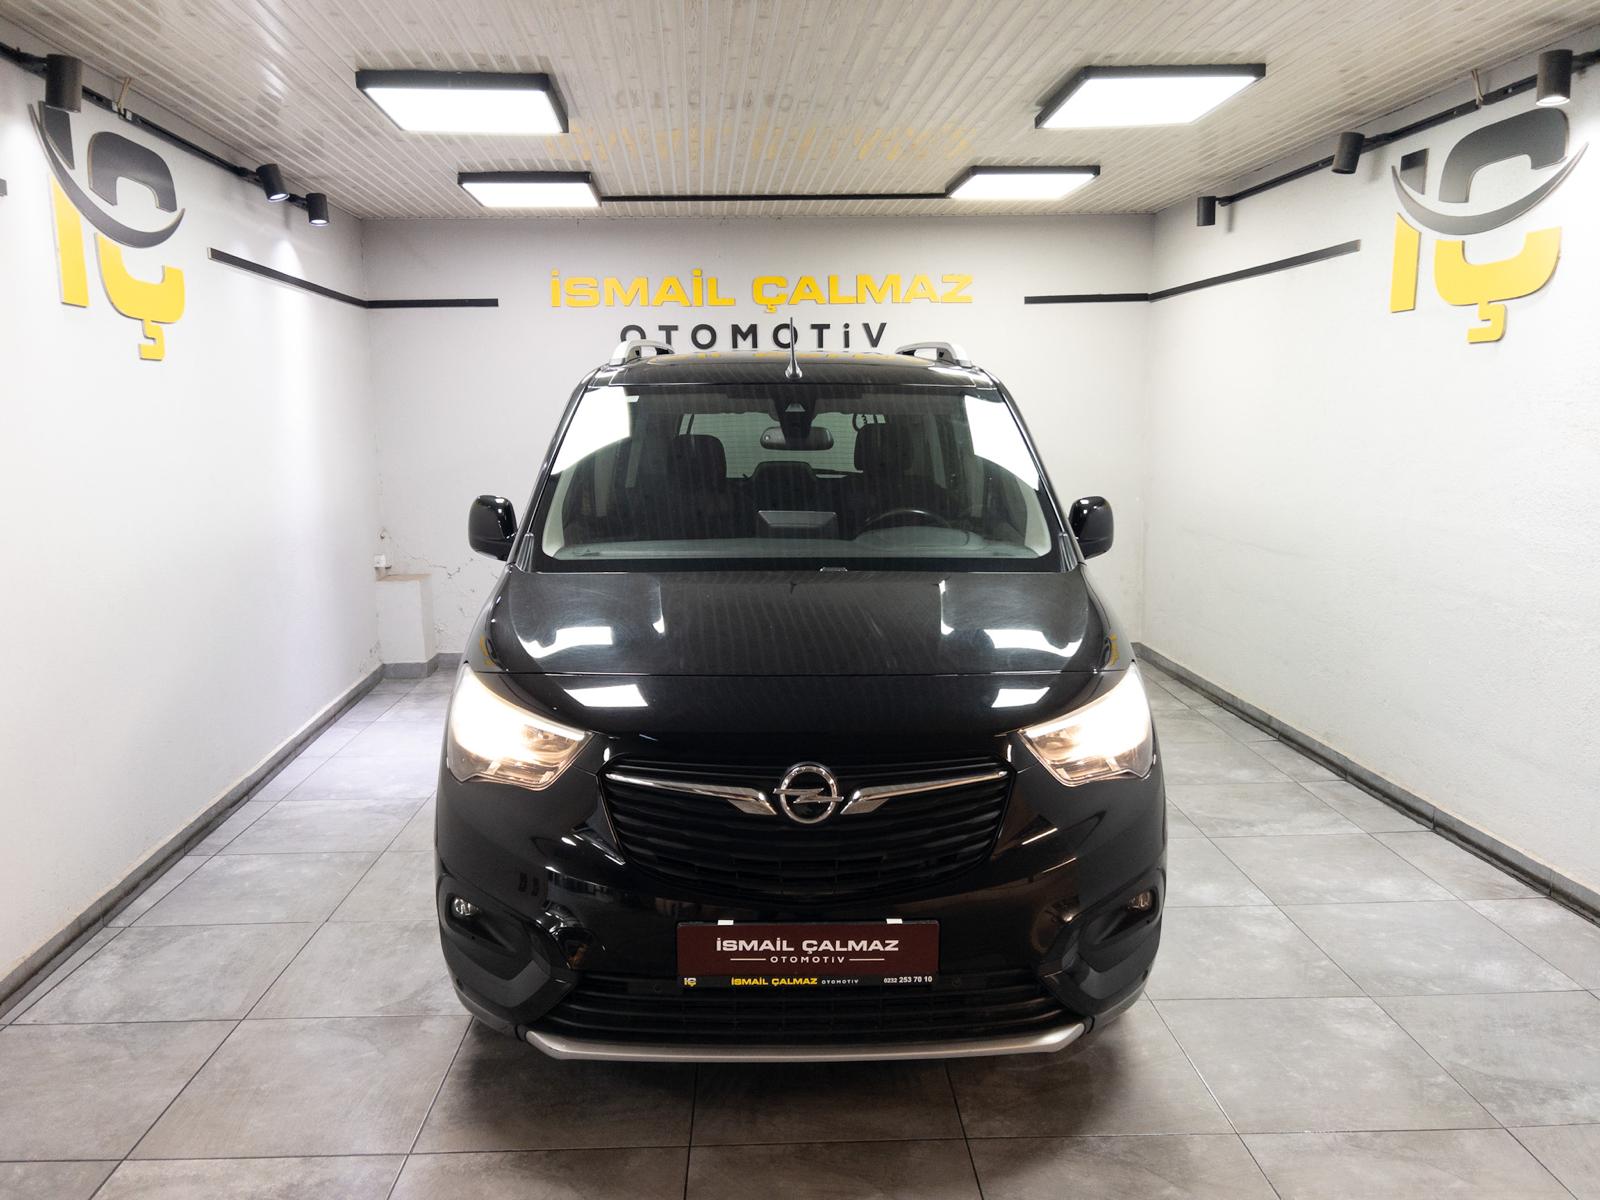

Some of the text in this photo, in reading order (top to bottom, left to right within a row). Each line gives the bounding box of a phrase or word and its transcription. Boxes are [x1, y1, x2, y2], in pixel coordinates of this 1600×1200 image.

[551, 269, 974, 313] İSMAİL ÇALMAZ
[716, 937, 899, 954] İSMAİL ÇALMAZ
[771, 977, 818, 987] ÇALMAZ
[898, 975, 912, 983] 253
[913, 975, 923, 983] 70
[924, 975, 933, 983] 10
